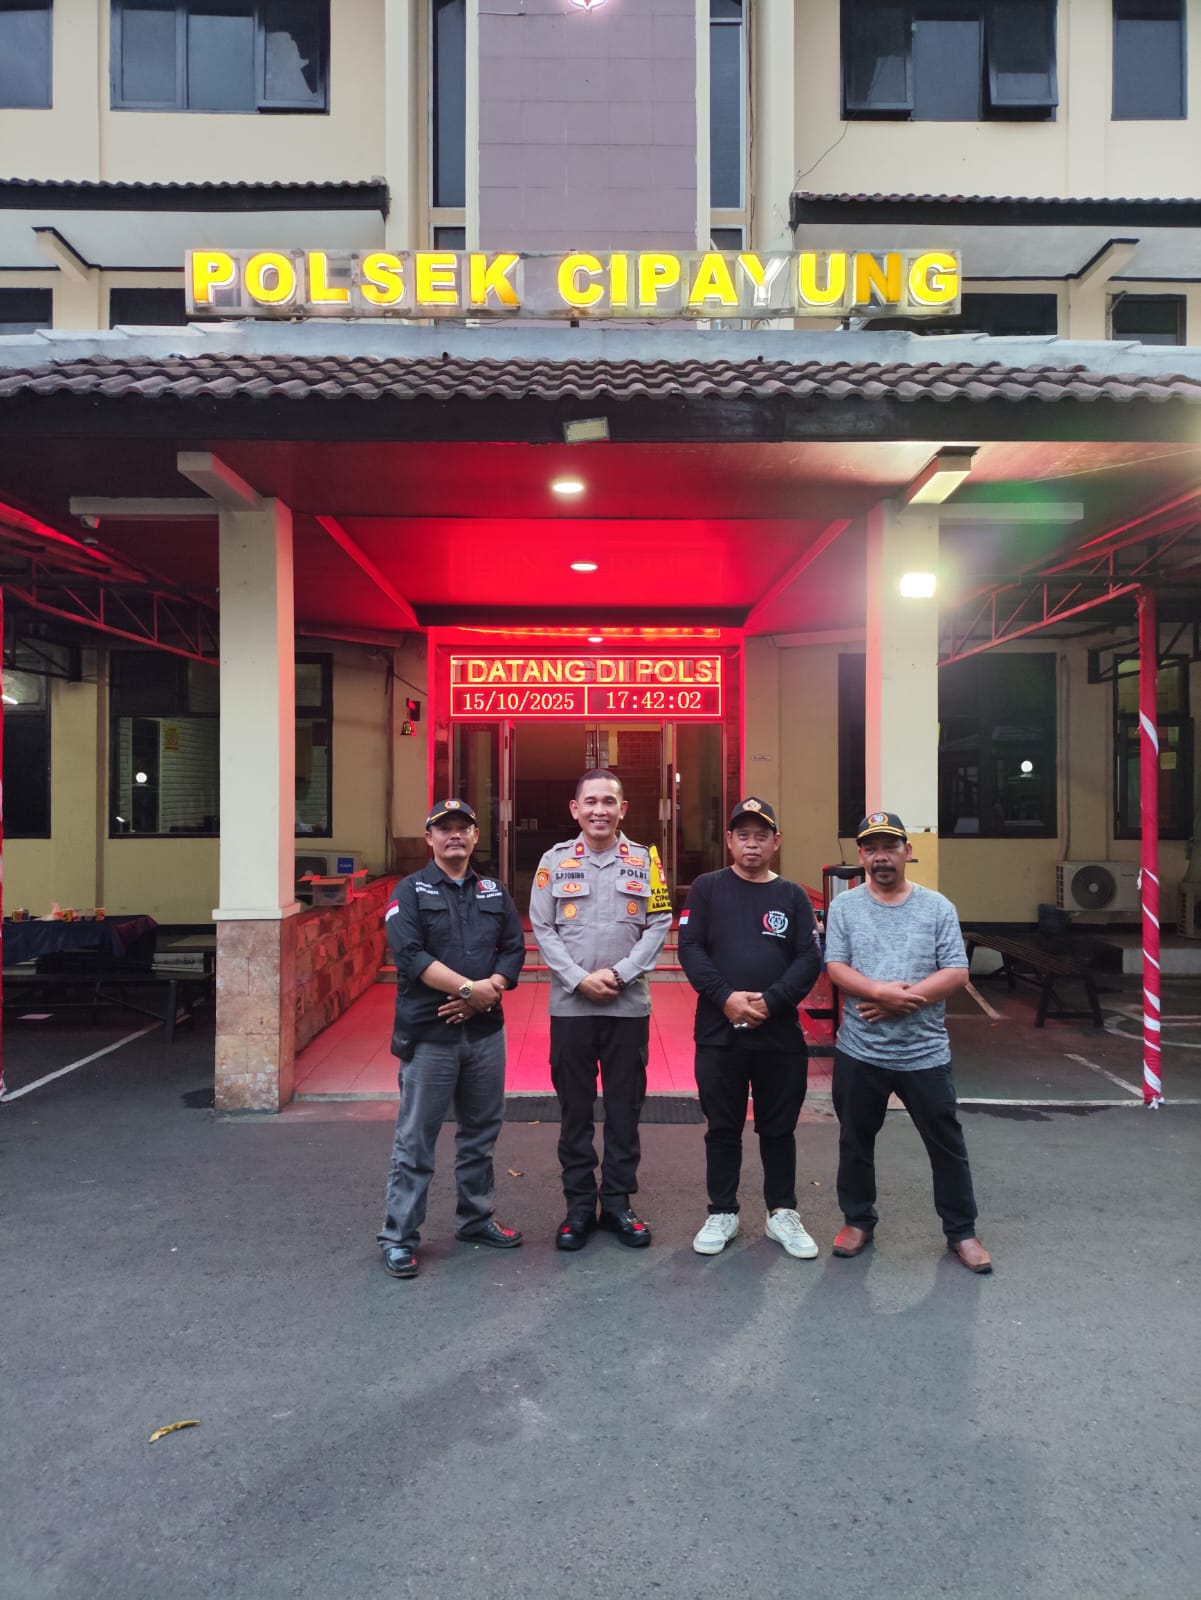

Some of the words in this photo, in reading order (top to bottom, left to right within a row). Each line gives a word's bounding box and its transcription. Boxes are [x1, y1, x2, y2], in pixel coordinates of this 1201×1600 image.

[192, 252, 521, 306] POLSEK
[556, 252, 959, 306] CIPAYUNG
[467, 659, 587, 683] DATANG
[596, 659, 626, 683] DI
[463, 690, 575, 712] 15/10/2025
[606, 691, 702, 710] 17:42:02
[620, 869, 647, 880] POLRI
